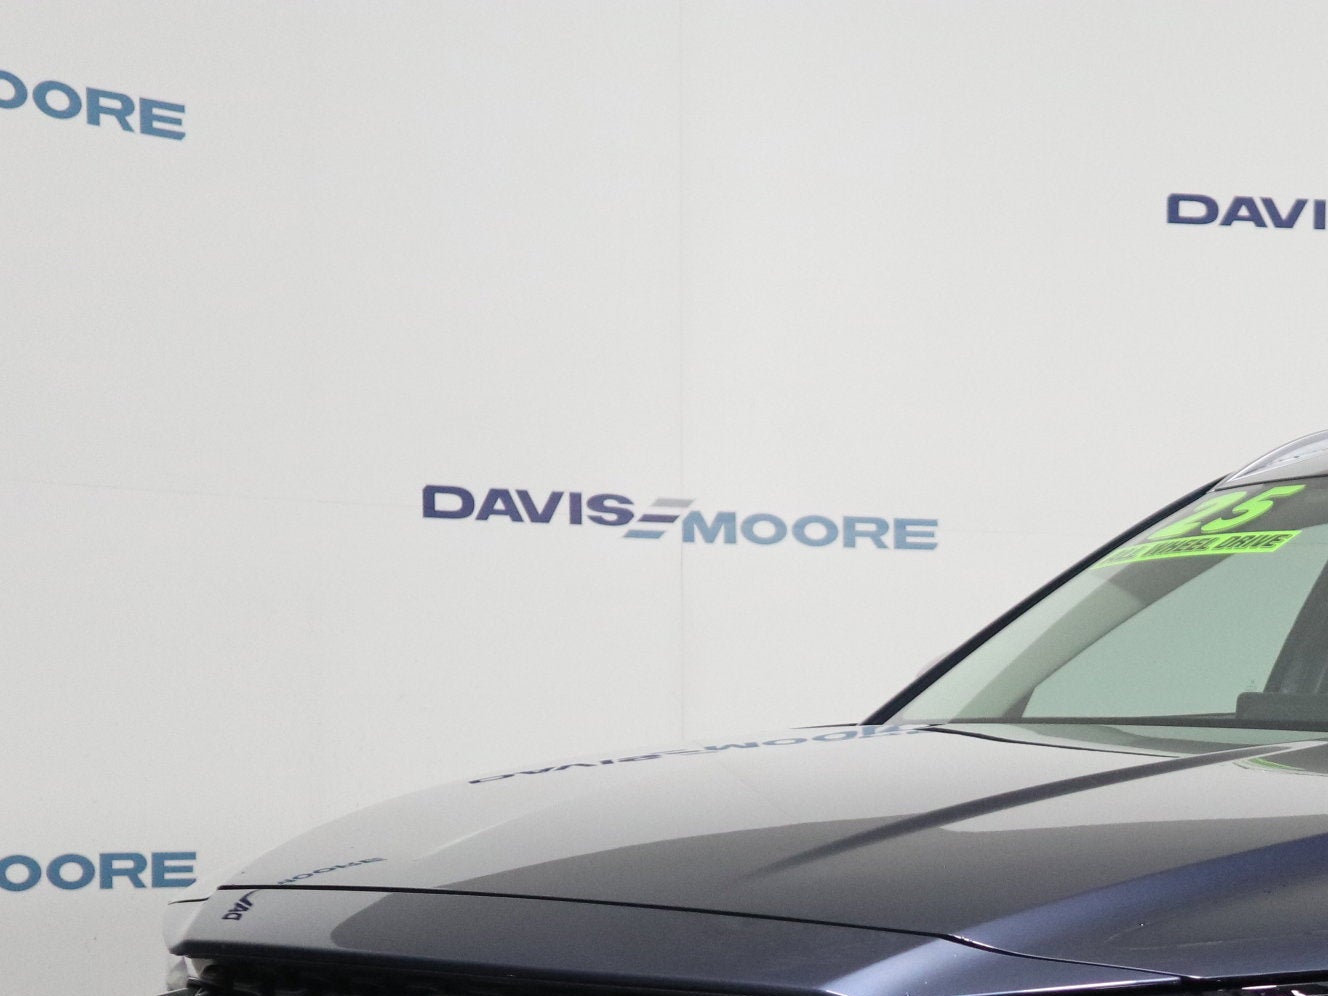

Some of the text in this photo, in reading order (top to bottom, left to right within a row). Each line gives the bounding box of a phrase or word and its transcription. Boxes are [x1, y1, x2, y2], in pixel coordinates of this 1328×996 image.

[422, 484, 939, 551] DAVIS MOORE
[1147, 484, 1306, 539] 25
[1140, 537, 1221, 558] WHEEL
[1213, 534, 1294, 550] DRIVE
